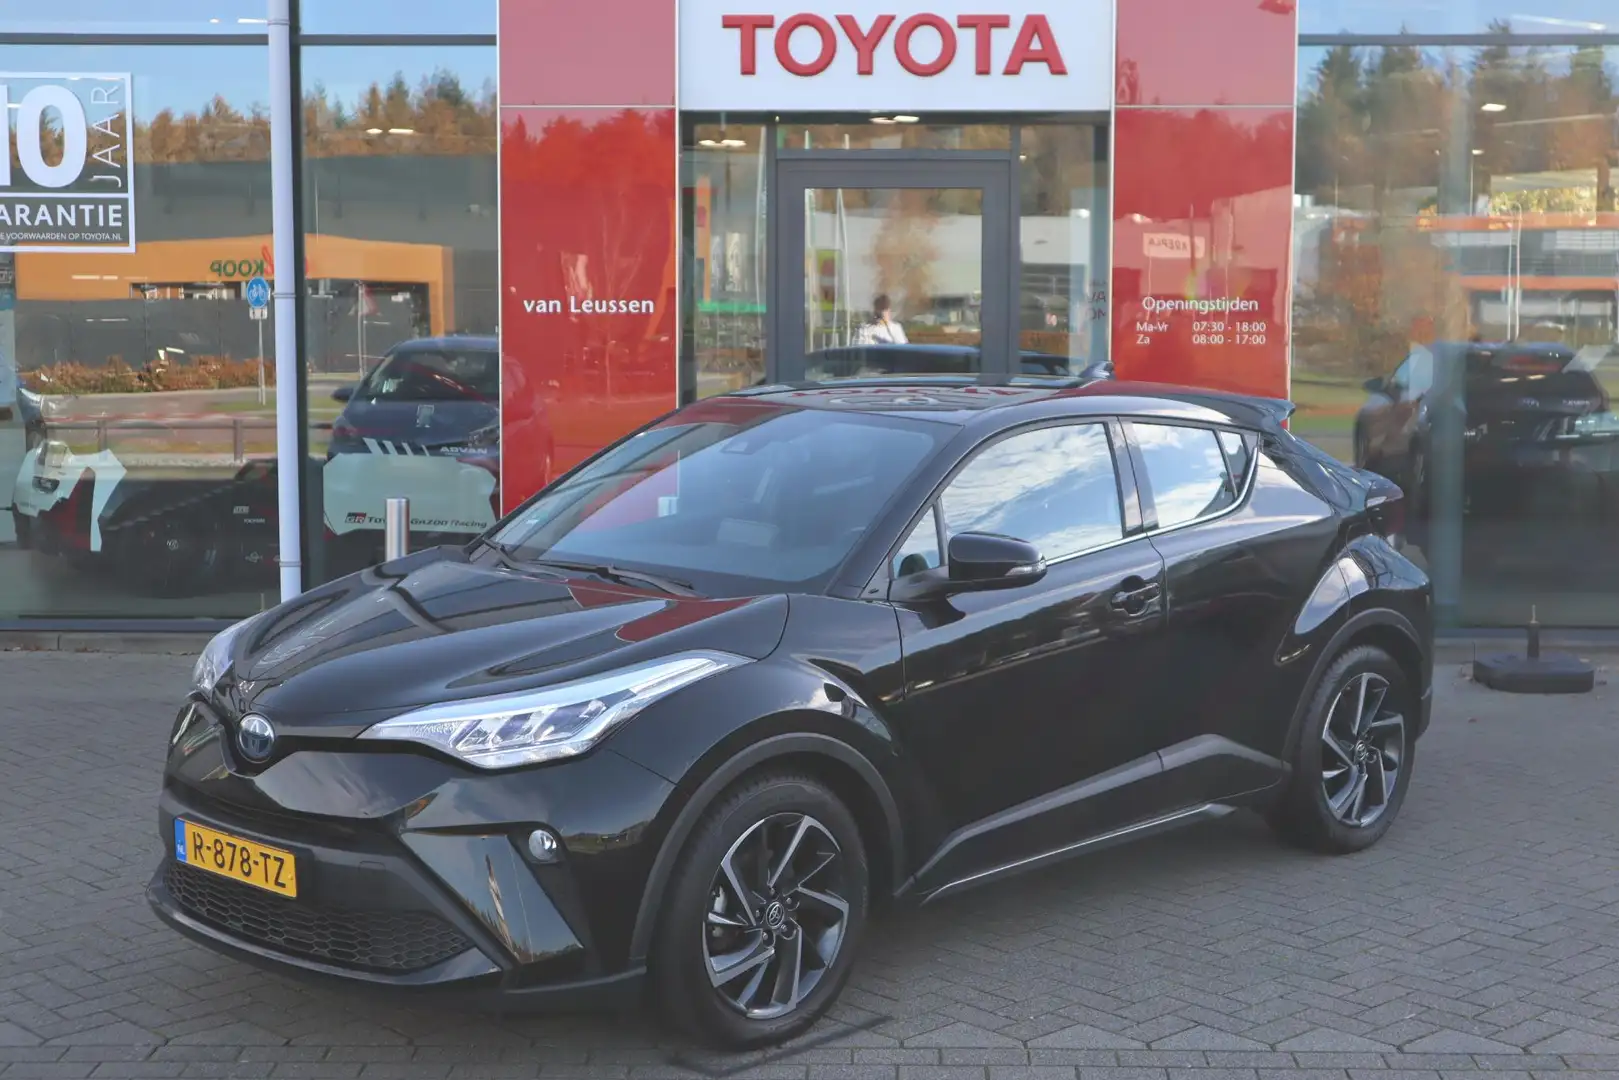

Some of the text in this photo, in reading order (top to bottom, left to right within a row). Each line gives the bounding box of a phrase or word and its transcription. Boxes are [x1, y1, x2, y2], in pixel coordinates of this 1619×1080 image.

[722, 13, 1068, 76] TOYOTA
[91, 86, 121, 188] JAAR
[6, 232, 67, 240] VOORWAARDEN
[68, 232, 80, 240] OP
[82, 232, 122, 241] TOYOTA.NL
[523, 295, 655, 313] van Leussen
[1142, 296, 1259, 315] Openingstijden
[1136, 322, 1168, 332] Ma-Vr
[1193, 322, 1224, 332] 07:30
[1235, 322, 1267, 332] 18:00
[1136, 334, 1150, 344] Za
[1193, 334, 1224, 344] 08:00
[1235, 334, 1267, 344] 17:00
[192, 831, 287, 889] R-878-TZ
